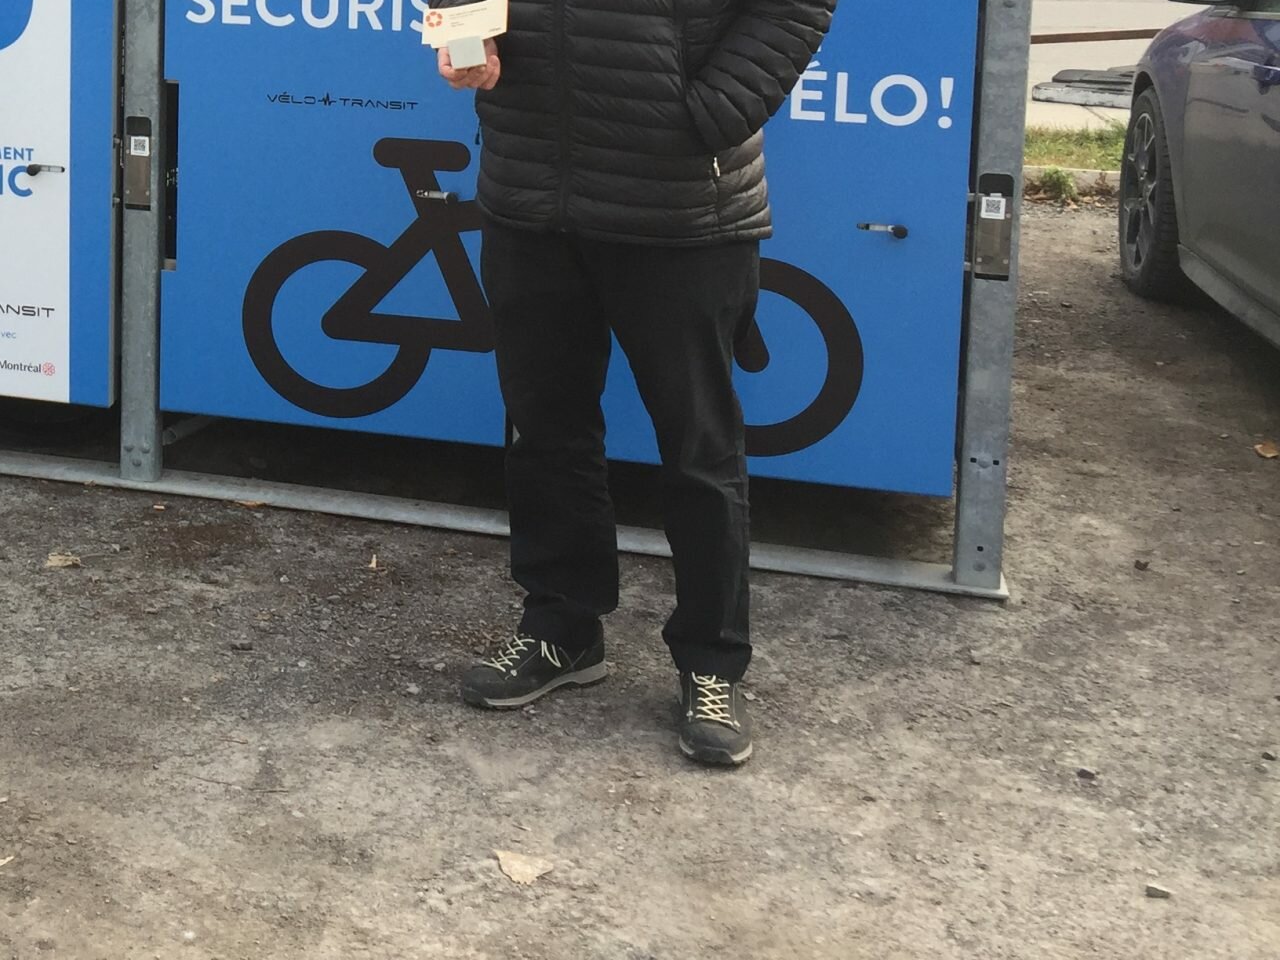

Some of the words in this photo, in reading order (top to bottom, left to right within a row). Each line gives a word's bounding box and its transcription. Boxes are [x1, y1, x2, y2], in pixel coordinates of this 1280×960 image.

[266, 91, 316, 105] VÉLO
[339, 97, 419, 110] TRANSIT
[790, 60, 954, 129] ÉLO!
